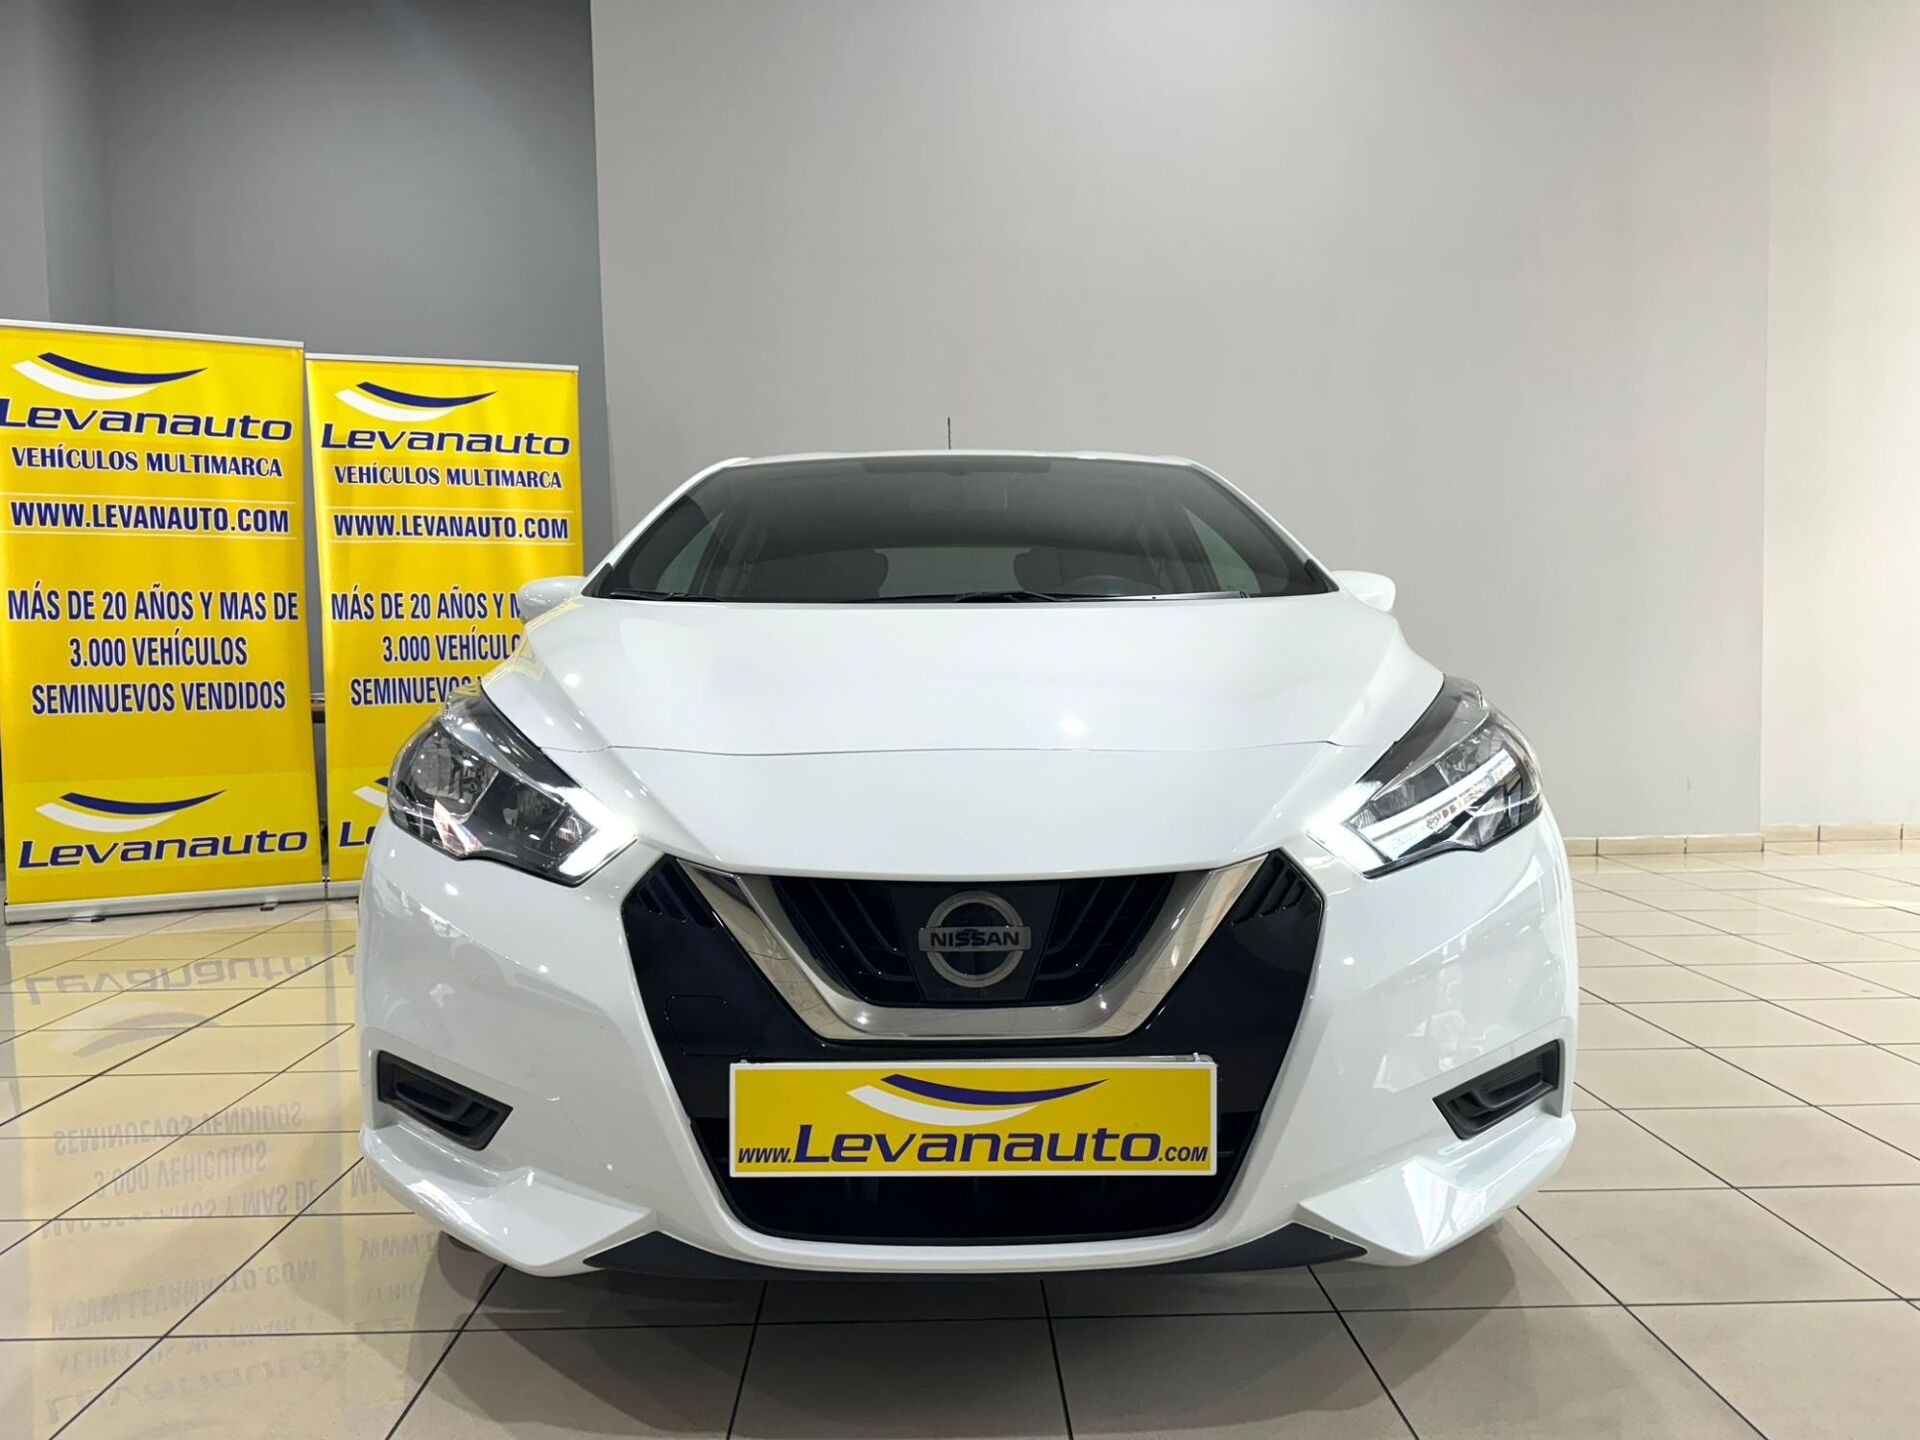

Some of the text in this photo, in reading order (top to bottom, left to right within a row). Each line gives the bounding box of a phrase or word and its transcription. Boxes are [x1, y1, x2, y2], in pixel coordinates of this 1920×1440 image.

[0, 398, 293, 441] Levanauto
[321, 423, 570, 456] Levanauto
[11, 443, 283, 477] VEHÍCULOS MULTIMARCA
[334, 463, 562, 488] VEHÍCULOS MULTIMARCA
[11, 501, 289, 533] WWW.LEVANAUTO.COM
[334, 514, 569, 539] WWW.LEVANAUTO.COM
[8, 581, 299, 620] MÁS DE 20 AÑOS Y MAS DE
[331, 585, 374, 620] MÁS
[381, 592, 404, 619] DE
[410, 593, 431, 619] 20
[437, 586, 488, 619] AÑOS
[492, 593, 504, 619] Y
[69, 629, 248, 667] 3.000 VEHÍCULOS
[382, 626, 520, 662] 3.000 VEHÍCULO
[32, 681, 286, 714] SEMINUEVOS VENDIDOS
[18, 830, 308, 869] Levanauto
[930, 931, 1019, 947] NISSAN
